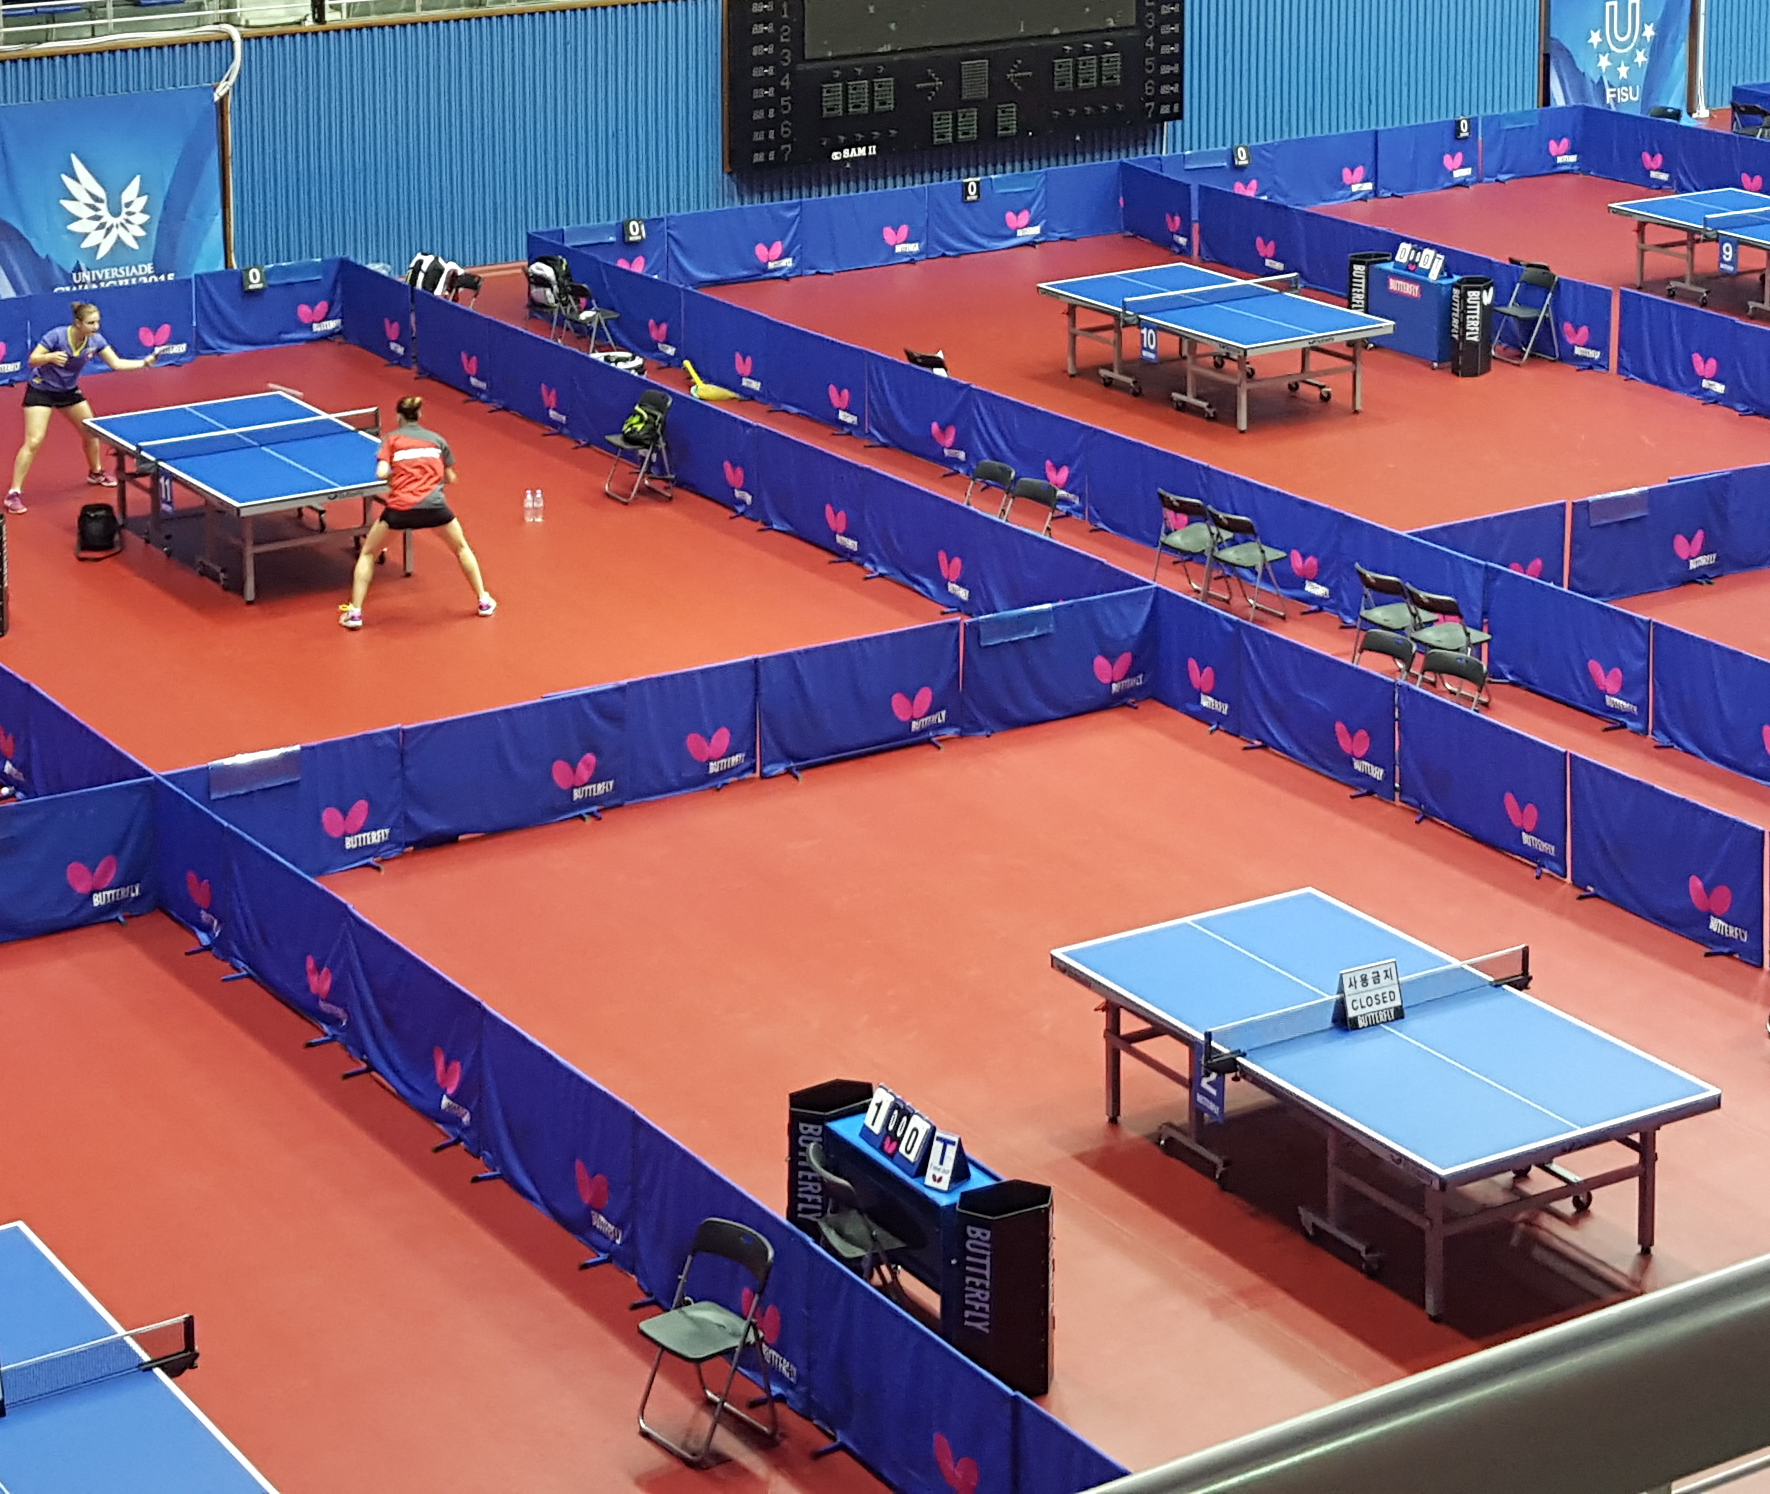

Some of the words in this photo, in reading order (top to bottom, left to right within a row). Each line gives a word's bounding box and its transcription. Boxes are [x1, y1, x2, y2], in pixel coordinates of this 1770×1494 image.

[781, 3, 789, 18] 1
[780, 25, 792, 43] 2
[780, 49, 792, 66] 3
[780, 73, 792, 90] 4
[1606, 85, 1640, 104] FISU
[780, 97, 793, 114] 5
[780, 122, 793, 138] 6
[1461, 120, 1467, 132] 0
[780, 146, 793, 162] 7
[843, 147, 866, 159] SAM
[1238, 147, 1246, 160] 0
[968, 181, 977, 195] 0
[629, 221, 640, 236] 0
[1721, 243, 1733, 263] 9
[72, 263, 154, 283] UNIVERSIADE
[249, 268, 260, 283] 0
[1389, 277, 1421, 298] BUTTERFLY
[1466, 290, 1481, 342] BUTTERFLY
[1140, 329, 1157, 350] 10
[912, 711, 946, 731] BUTTERFLY
[709, 753, 745, 773] BUTTERFLY
[1353, 758, 1384, 780] BUTTERFLY
[573, 780, 614, 800] BUTTERFLY
[345, 829, 390, 849] BUTTERFLY
[1522, 831, 1555, 857] BUTTERFLY
[93, 884, 139, 906] BUTTERFLY
[1709, 915, 1748, 943] BUTTERFLY
[1348, 967, 1394, 989] 사용금지
[1351, 990, 1396, 1010] CLOSED
[1357, 1008, 1395, 1028] BUTTERFLY
[872, 1098, 882, 1127] 1
[904, 1126, 920, 1155] 0
[935, 1135, 956, 1166] T
[964, 1225, 992, 1334] BUTTERFLY
